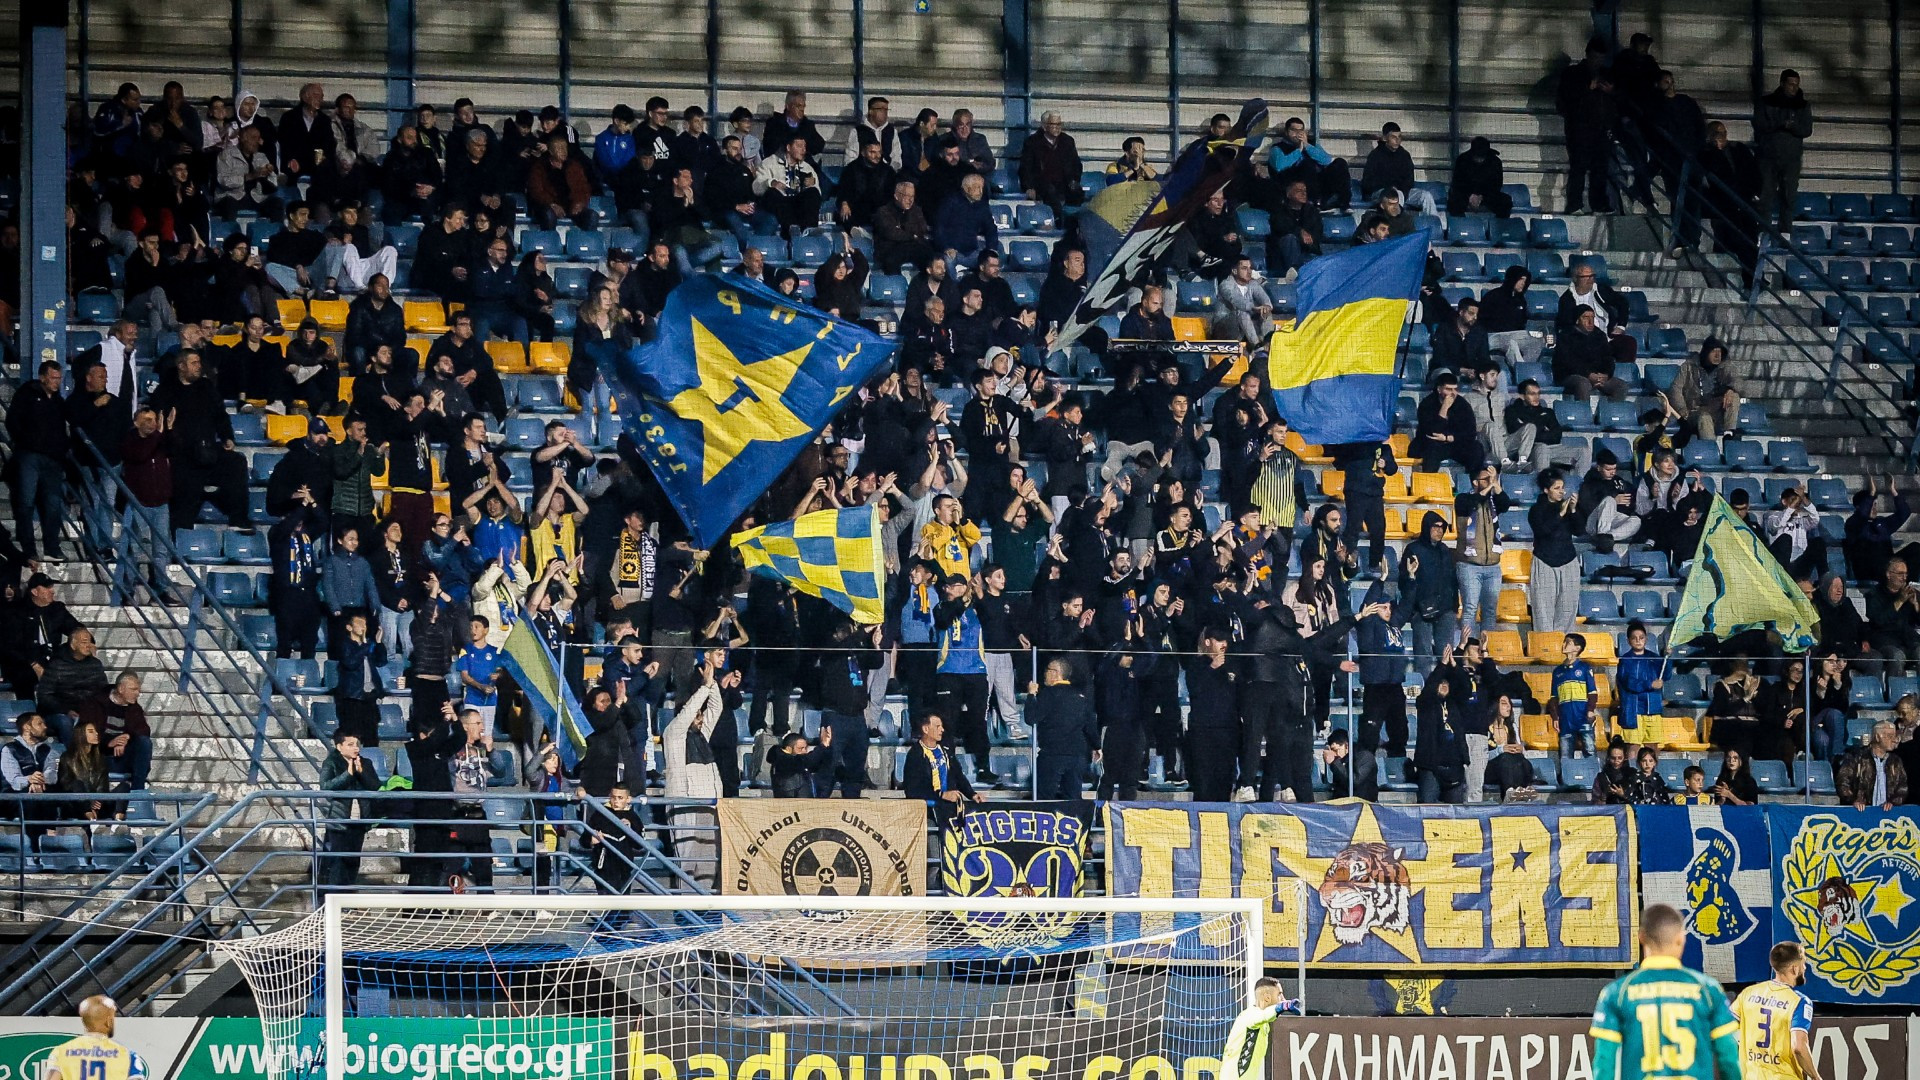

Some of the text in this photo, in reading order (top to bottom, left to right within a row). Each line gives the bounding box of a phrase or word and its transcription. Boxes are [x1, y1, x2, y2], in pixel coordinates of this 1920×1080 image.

[746, 811, 801, 858] School
[841, 810, 892, 851] Ultras
[949, 810, 1083, 847] TIGERS
[1805, 815, 1917, 864] Tigers
[1123, 808, 1620, 949] TIGERS
[1748, 995, 1789, 1010] novibet
[1636, 1003, 1697, 1073] 15
[1756, 1007, 1772, 1048] 3
[66, 1046, 119, 1058] novibet
[208, 1032, 593, 1080] wwwbiogreco.gr
